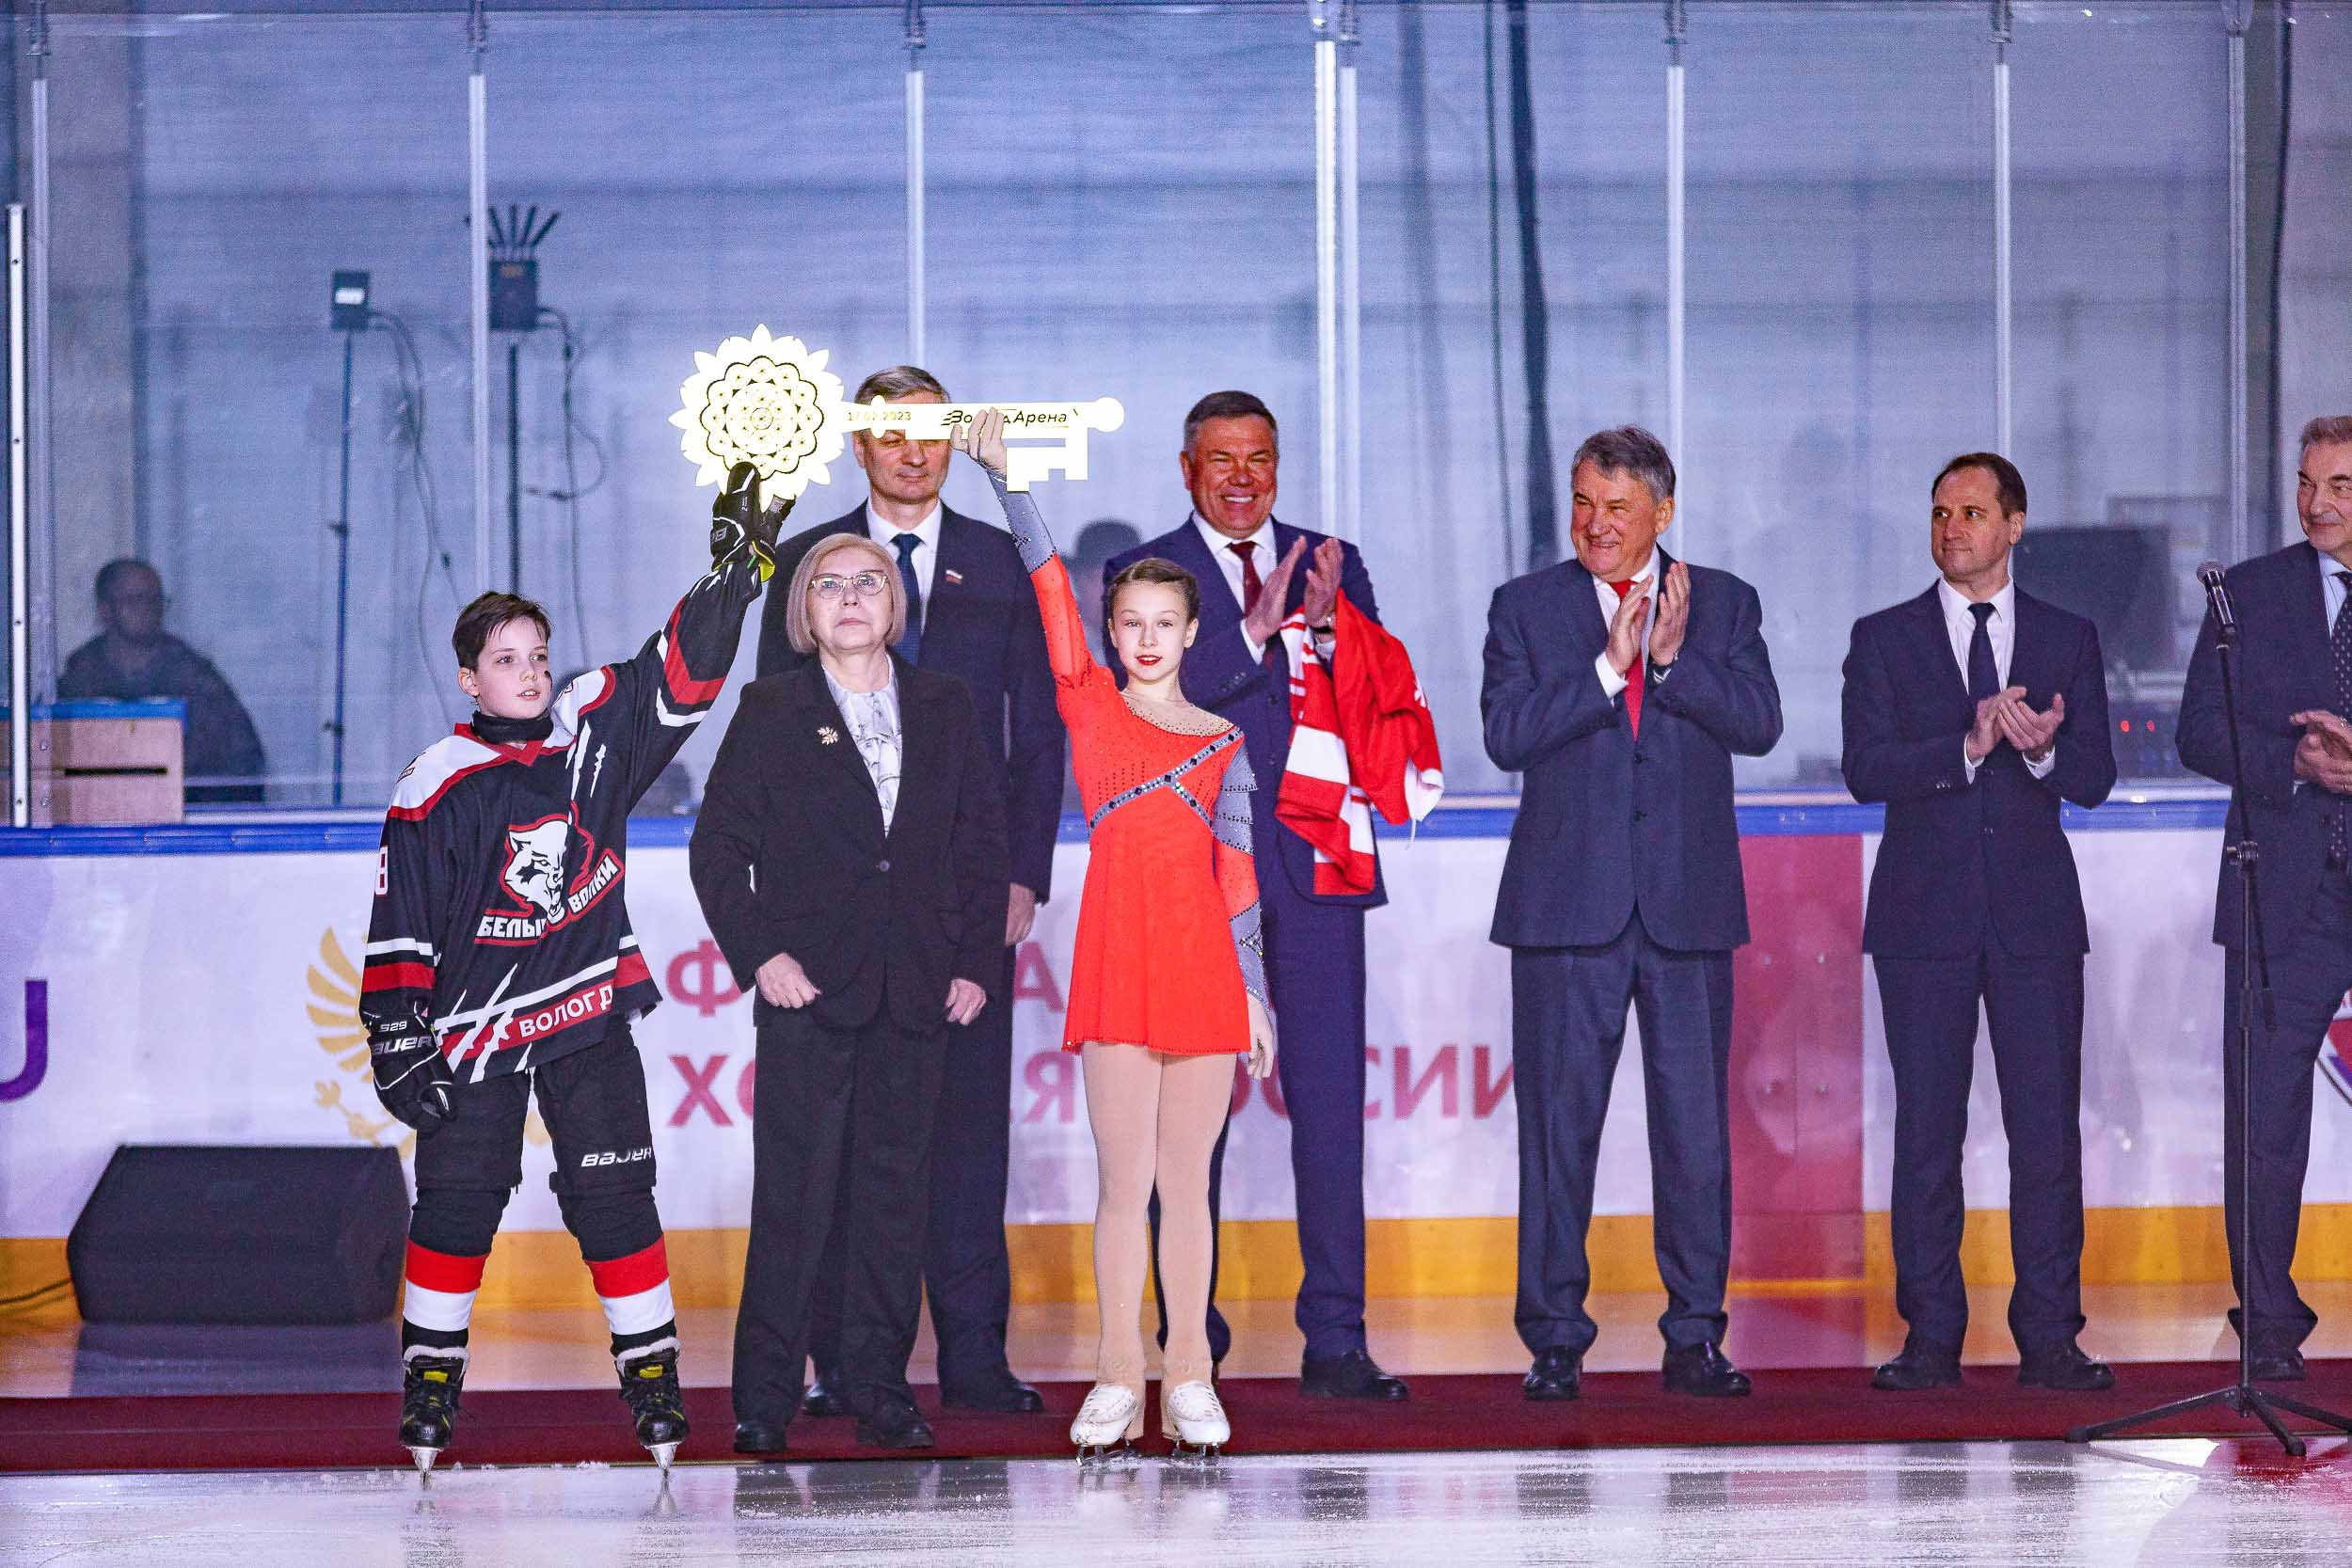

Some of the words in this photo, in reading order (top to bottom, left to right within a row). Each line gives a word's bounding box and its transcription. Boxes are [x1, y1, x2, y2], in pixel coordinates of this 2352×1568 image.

[567, 855, 619, 913] ВОЛКИ
[379, 1021, 407, 1032] S29
[519, 984, 613, 1038] ВОЛОГД
[372, 1036, 433, 1054] AUER
